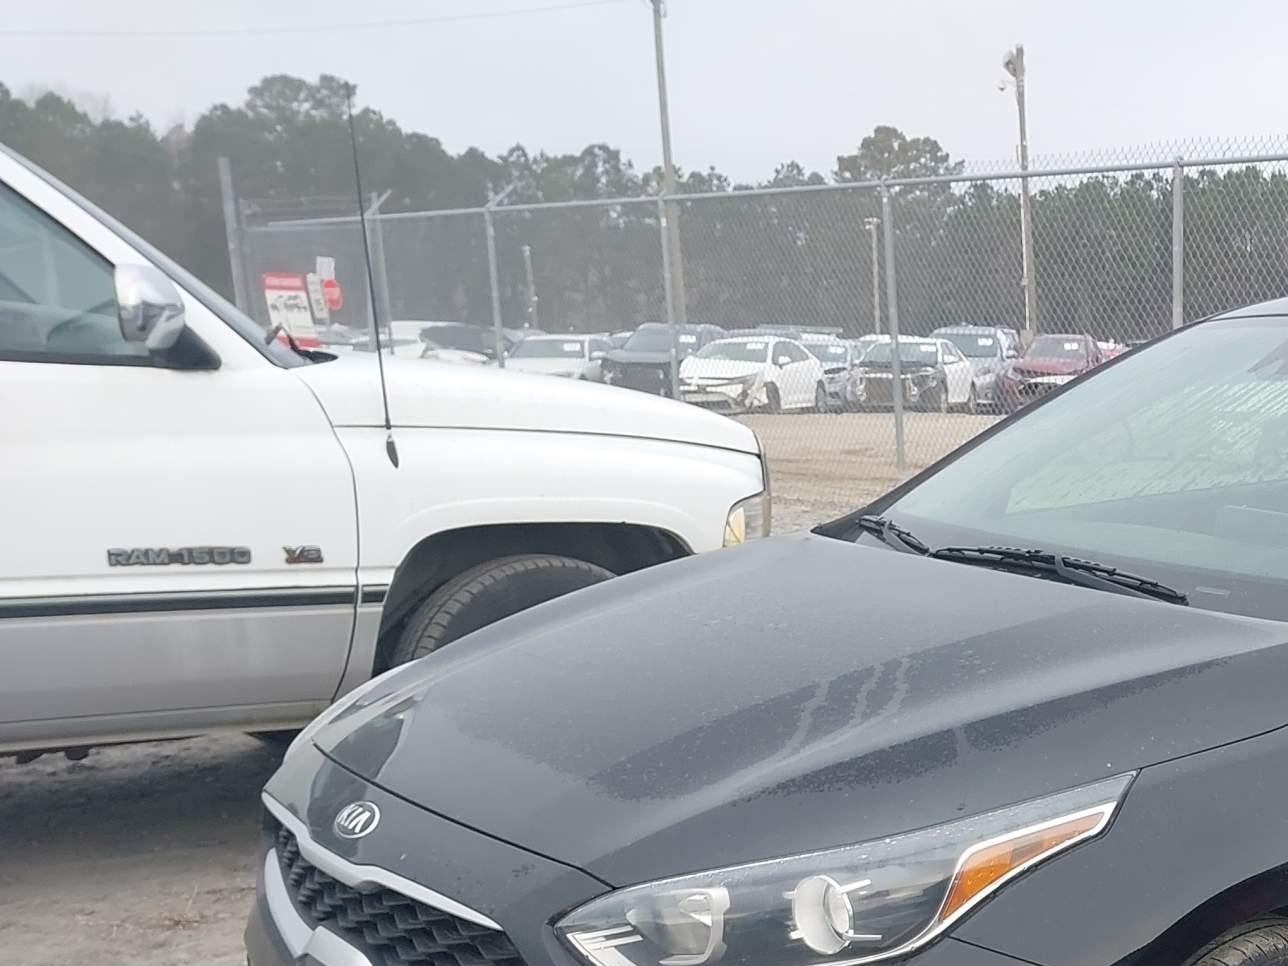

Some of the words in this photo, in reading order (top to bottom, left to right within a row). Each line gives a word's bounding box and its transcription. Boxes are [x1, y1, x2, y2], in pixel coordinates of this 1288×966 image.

[107, 547, 170, 567] RAM
[175, 546, 251, 565] 1500
[336, 802, 371, 834] KIA
